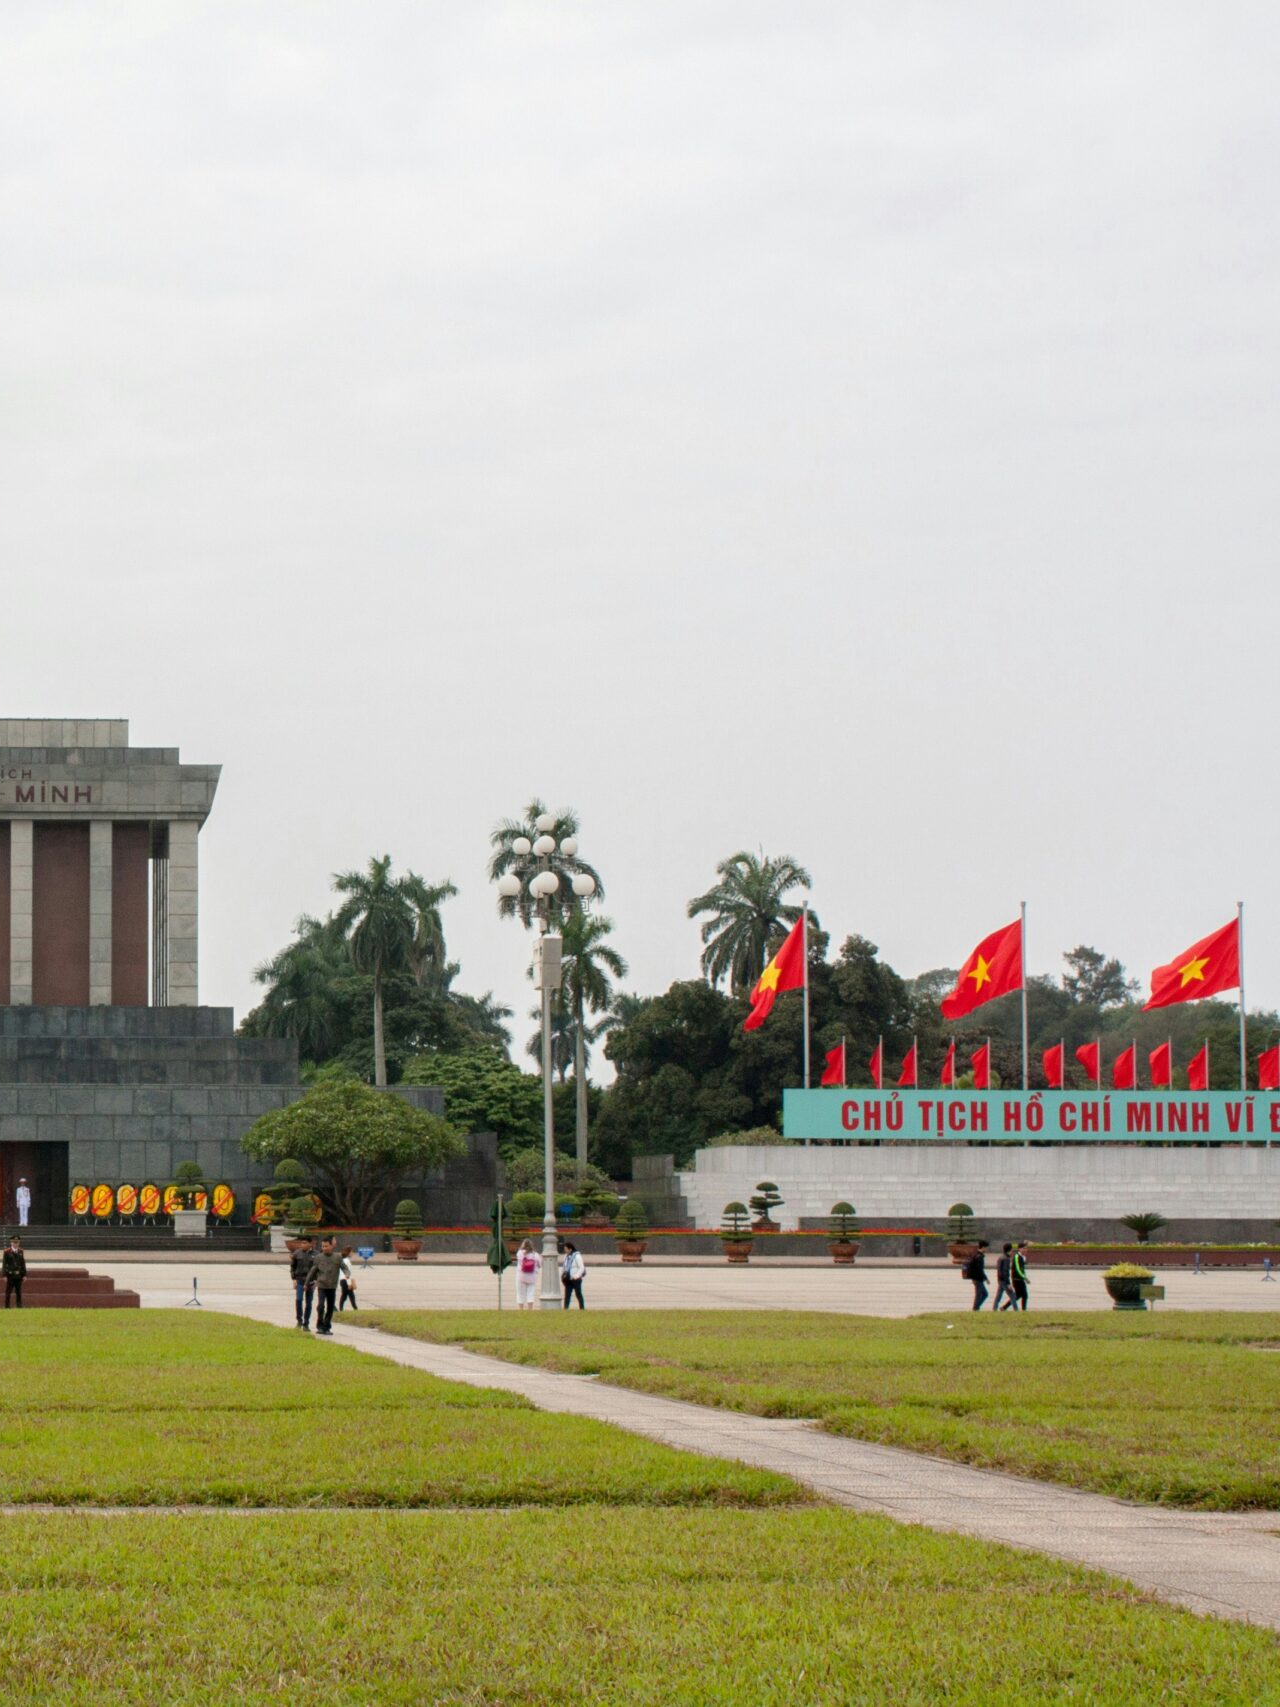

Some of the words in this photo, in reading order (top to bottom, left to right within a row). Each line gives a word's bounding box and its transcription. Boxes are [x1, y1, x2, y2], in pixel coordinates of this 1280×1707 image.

[841, 1092, 903, 1131] CHỦ
[918, 1101, 989, 1137] TỊCH
[1003, 1092, 1044, 1132] HỒ
[1058, 1096, 1112, 1132] CHÍ
[1126, 1102, 1210, 1133] MINH
[1225, 1096, 1255, 1133] VĨ
